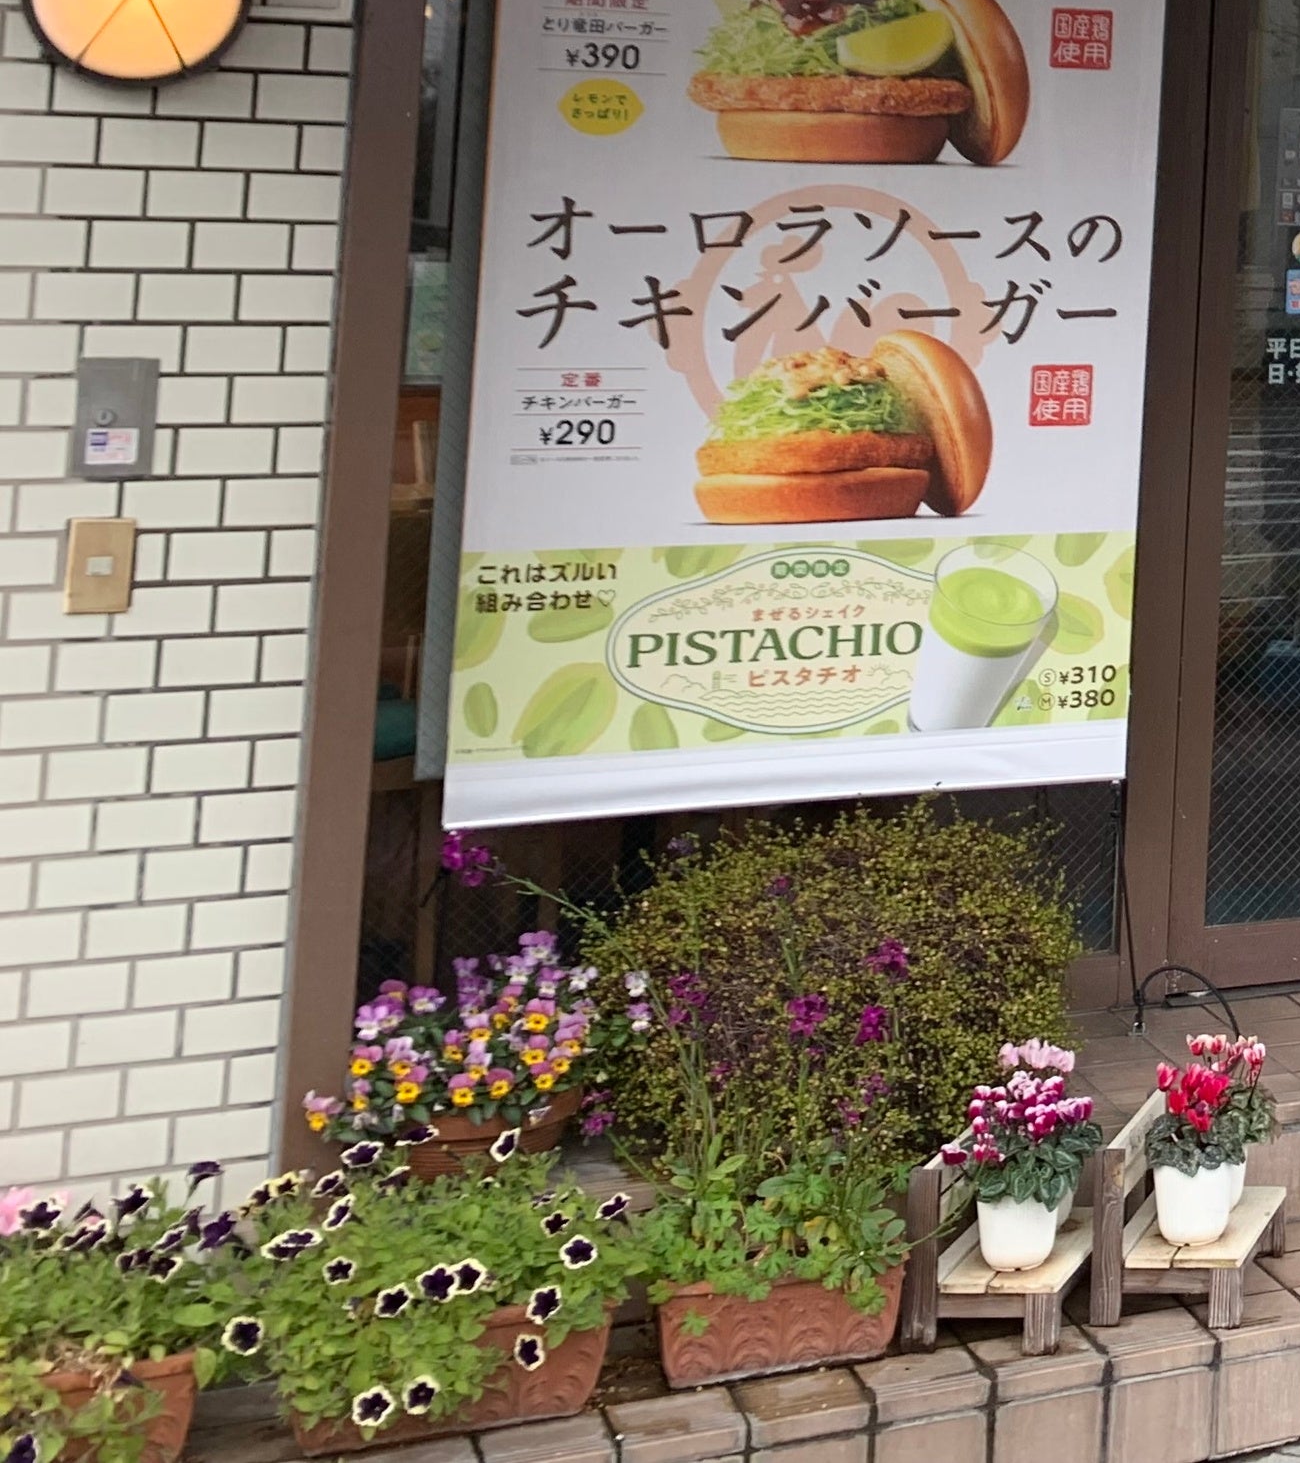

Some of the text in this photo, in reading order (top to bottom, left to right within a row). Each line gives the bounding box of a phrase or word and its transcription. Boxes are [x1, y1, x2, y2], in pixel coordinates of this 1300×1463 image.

[542, 16, 668, 36] とり竜田バーガー
[565, 42, 640, 70] ¥390
[1053, 40, 1108, 67] 使用
[572, 93, 627, 105] レモンで
[526, 196, 1124, 265] オーロラソースの
[515, 274, 1118, 350] チキンバーガー
[561, 372, 602, 388] 定番
[521, 394, 637, 410] チキンバーガー
[1032, 397, 1088, 421] 使用
[539, 419, 616, 445] ¥290
[477, 562, 618, 585] これはズルい
[474, 589, 593, 614] 組み合わせ
[751, 604, 867, 622] まぜるシェイク
[626, 621, 923, 669] PISTACHIO
[748, 665, 862, 688] ピスタチオ
[1059, 664, 1117, 685] ¥310
[1057, 689, 1115, 709] ¥380
